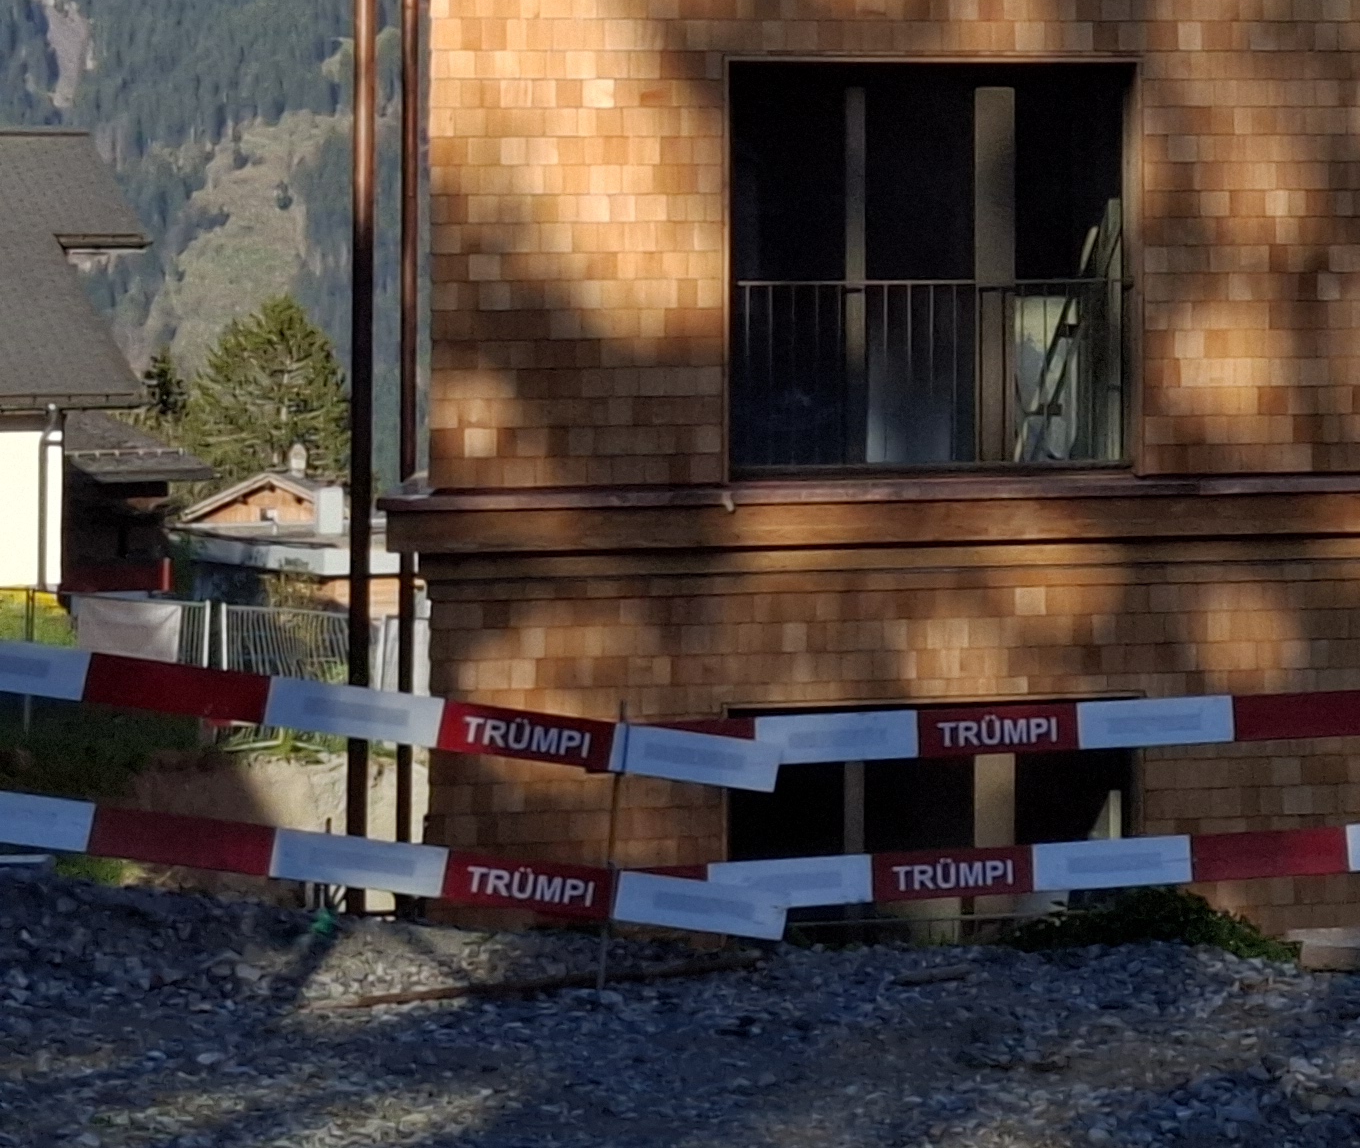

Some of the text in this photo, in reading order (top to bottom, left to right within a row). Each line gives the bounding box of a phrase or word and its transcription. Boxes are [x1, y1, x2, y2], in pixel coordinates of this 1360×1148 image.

[464, 716, 591, 758] TRÜMPI
[937, 714, 1058, 747] TRÜMPI
[467, 866, 595, 908] TRÜMPI
[892, 857, 1014, 891] TRÜMPI
